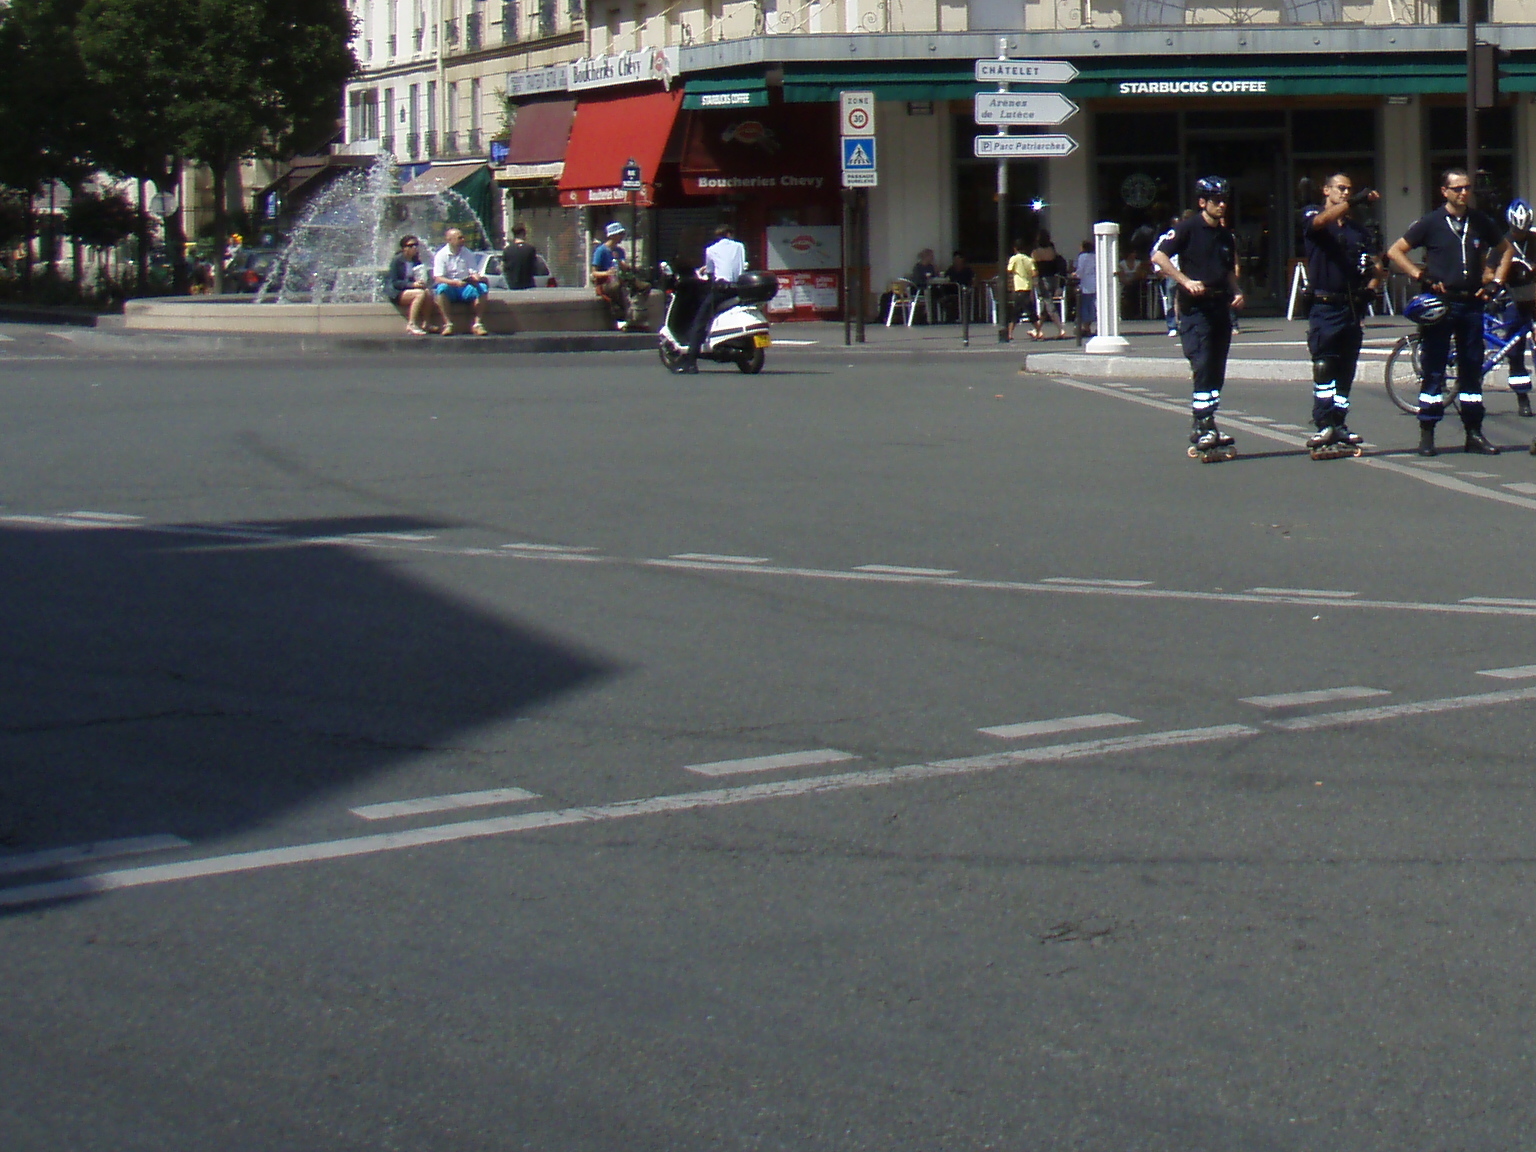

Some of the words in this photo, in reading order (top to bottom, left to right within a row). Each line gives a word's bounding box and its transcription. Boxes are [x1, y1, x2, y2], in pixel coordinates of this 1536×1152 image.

[573, 62, 614, 84] Boucheries
[981, 64, 1040, 76] CHÂTELET
[1119, 81, 1209, 94] STARBUCKS
[1211, 80, 1266, 93] COFFEE
[847, 97, 869, 105] ZONE
[853, 114, 864, 123] 30
[981, 110, 993, 119] de
[994, 142, 1014, 150] Parc
[1016, 141, 1066, 150] Patriarches
[698, 176, 776, 188] Boucheries
[780, 175, 824, 188] Chevy
